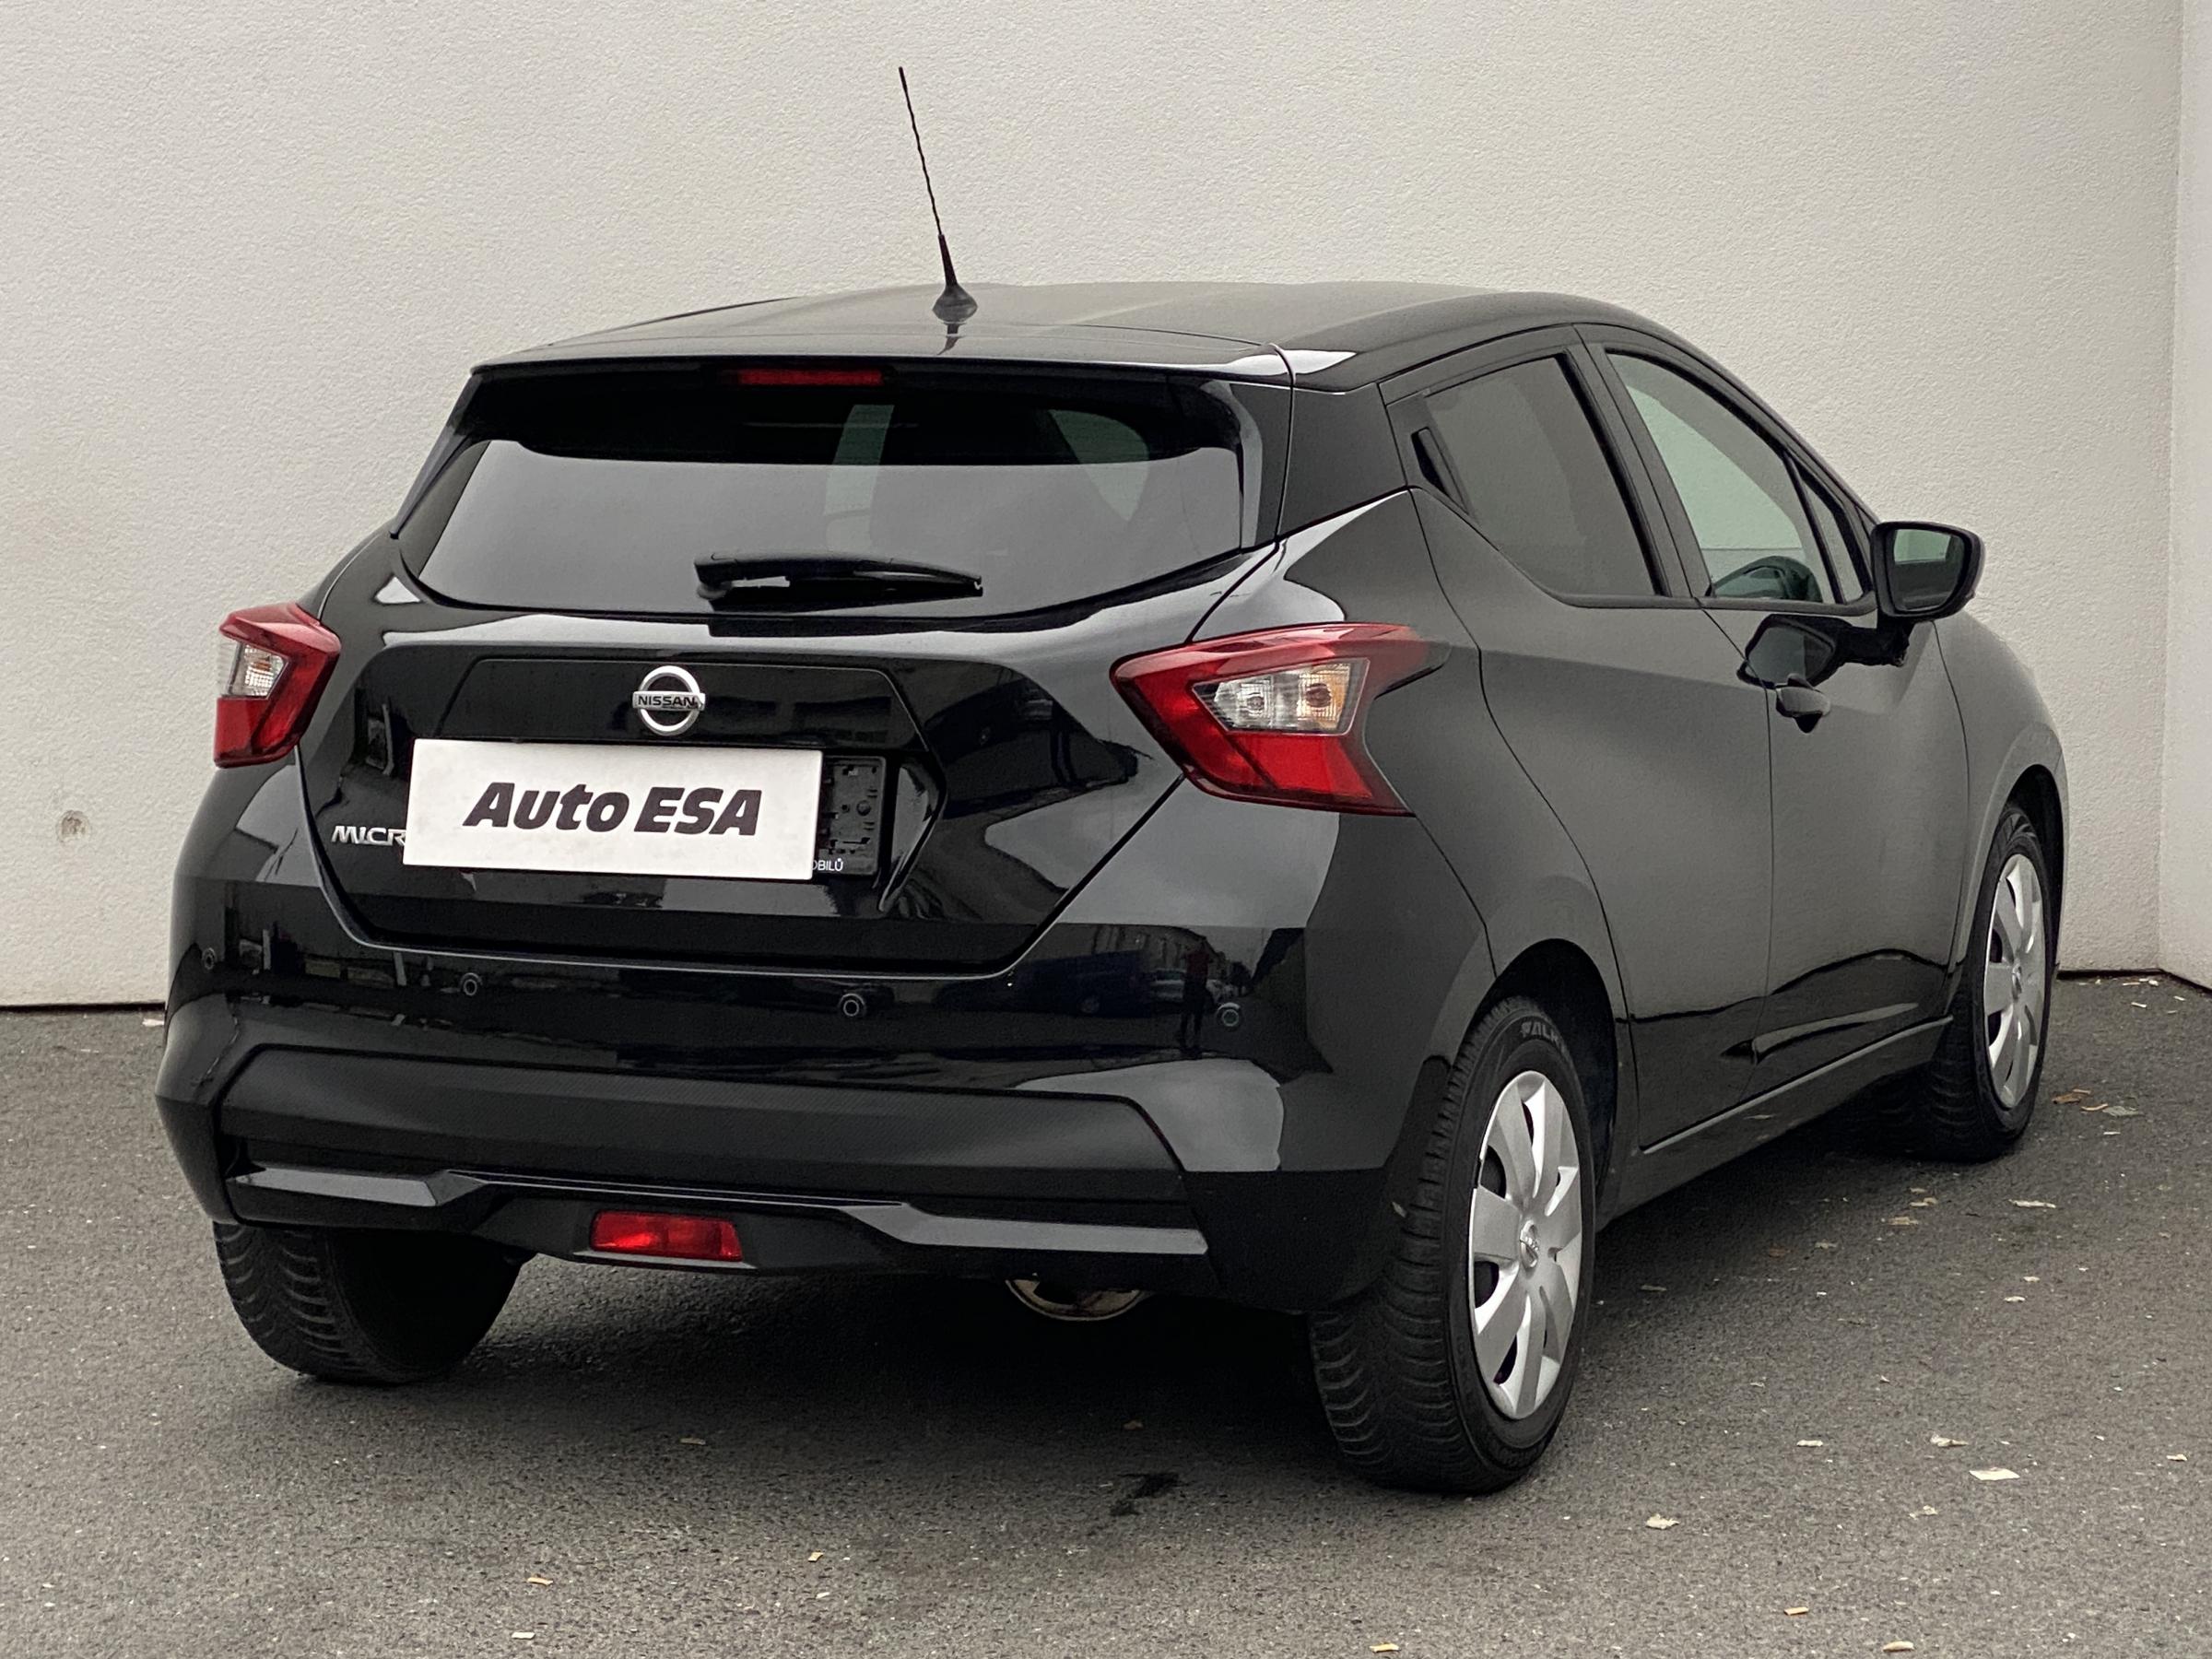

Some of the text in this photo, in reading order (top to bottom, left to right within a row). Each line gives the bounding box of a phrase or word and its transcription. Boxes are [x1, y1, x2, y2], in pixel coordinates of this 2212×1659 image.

[638, 696, 696, 707] NISSAN
[463, 782, 762, 835] Auto ESA
